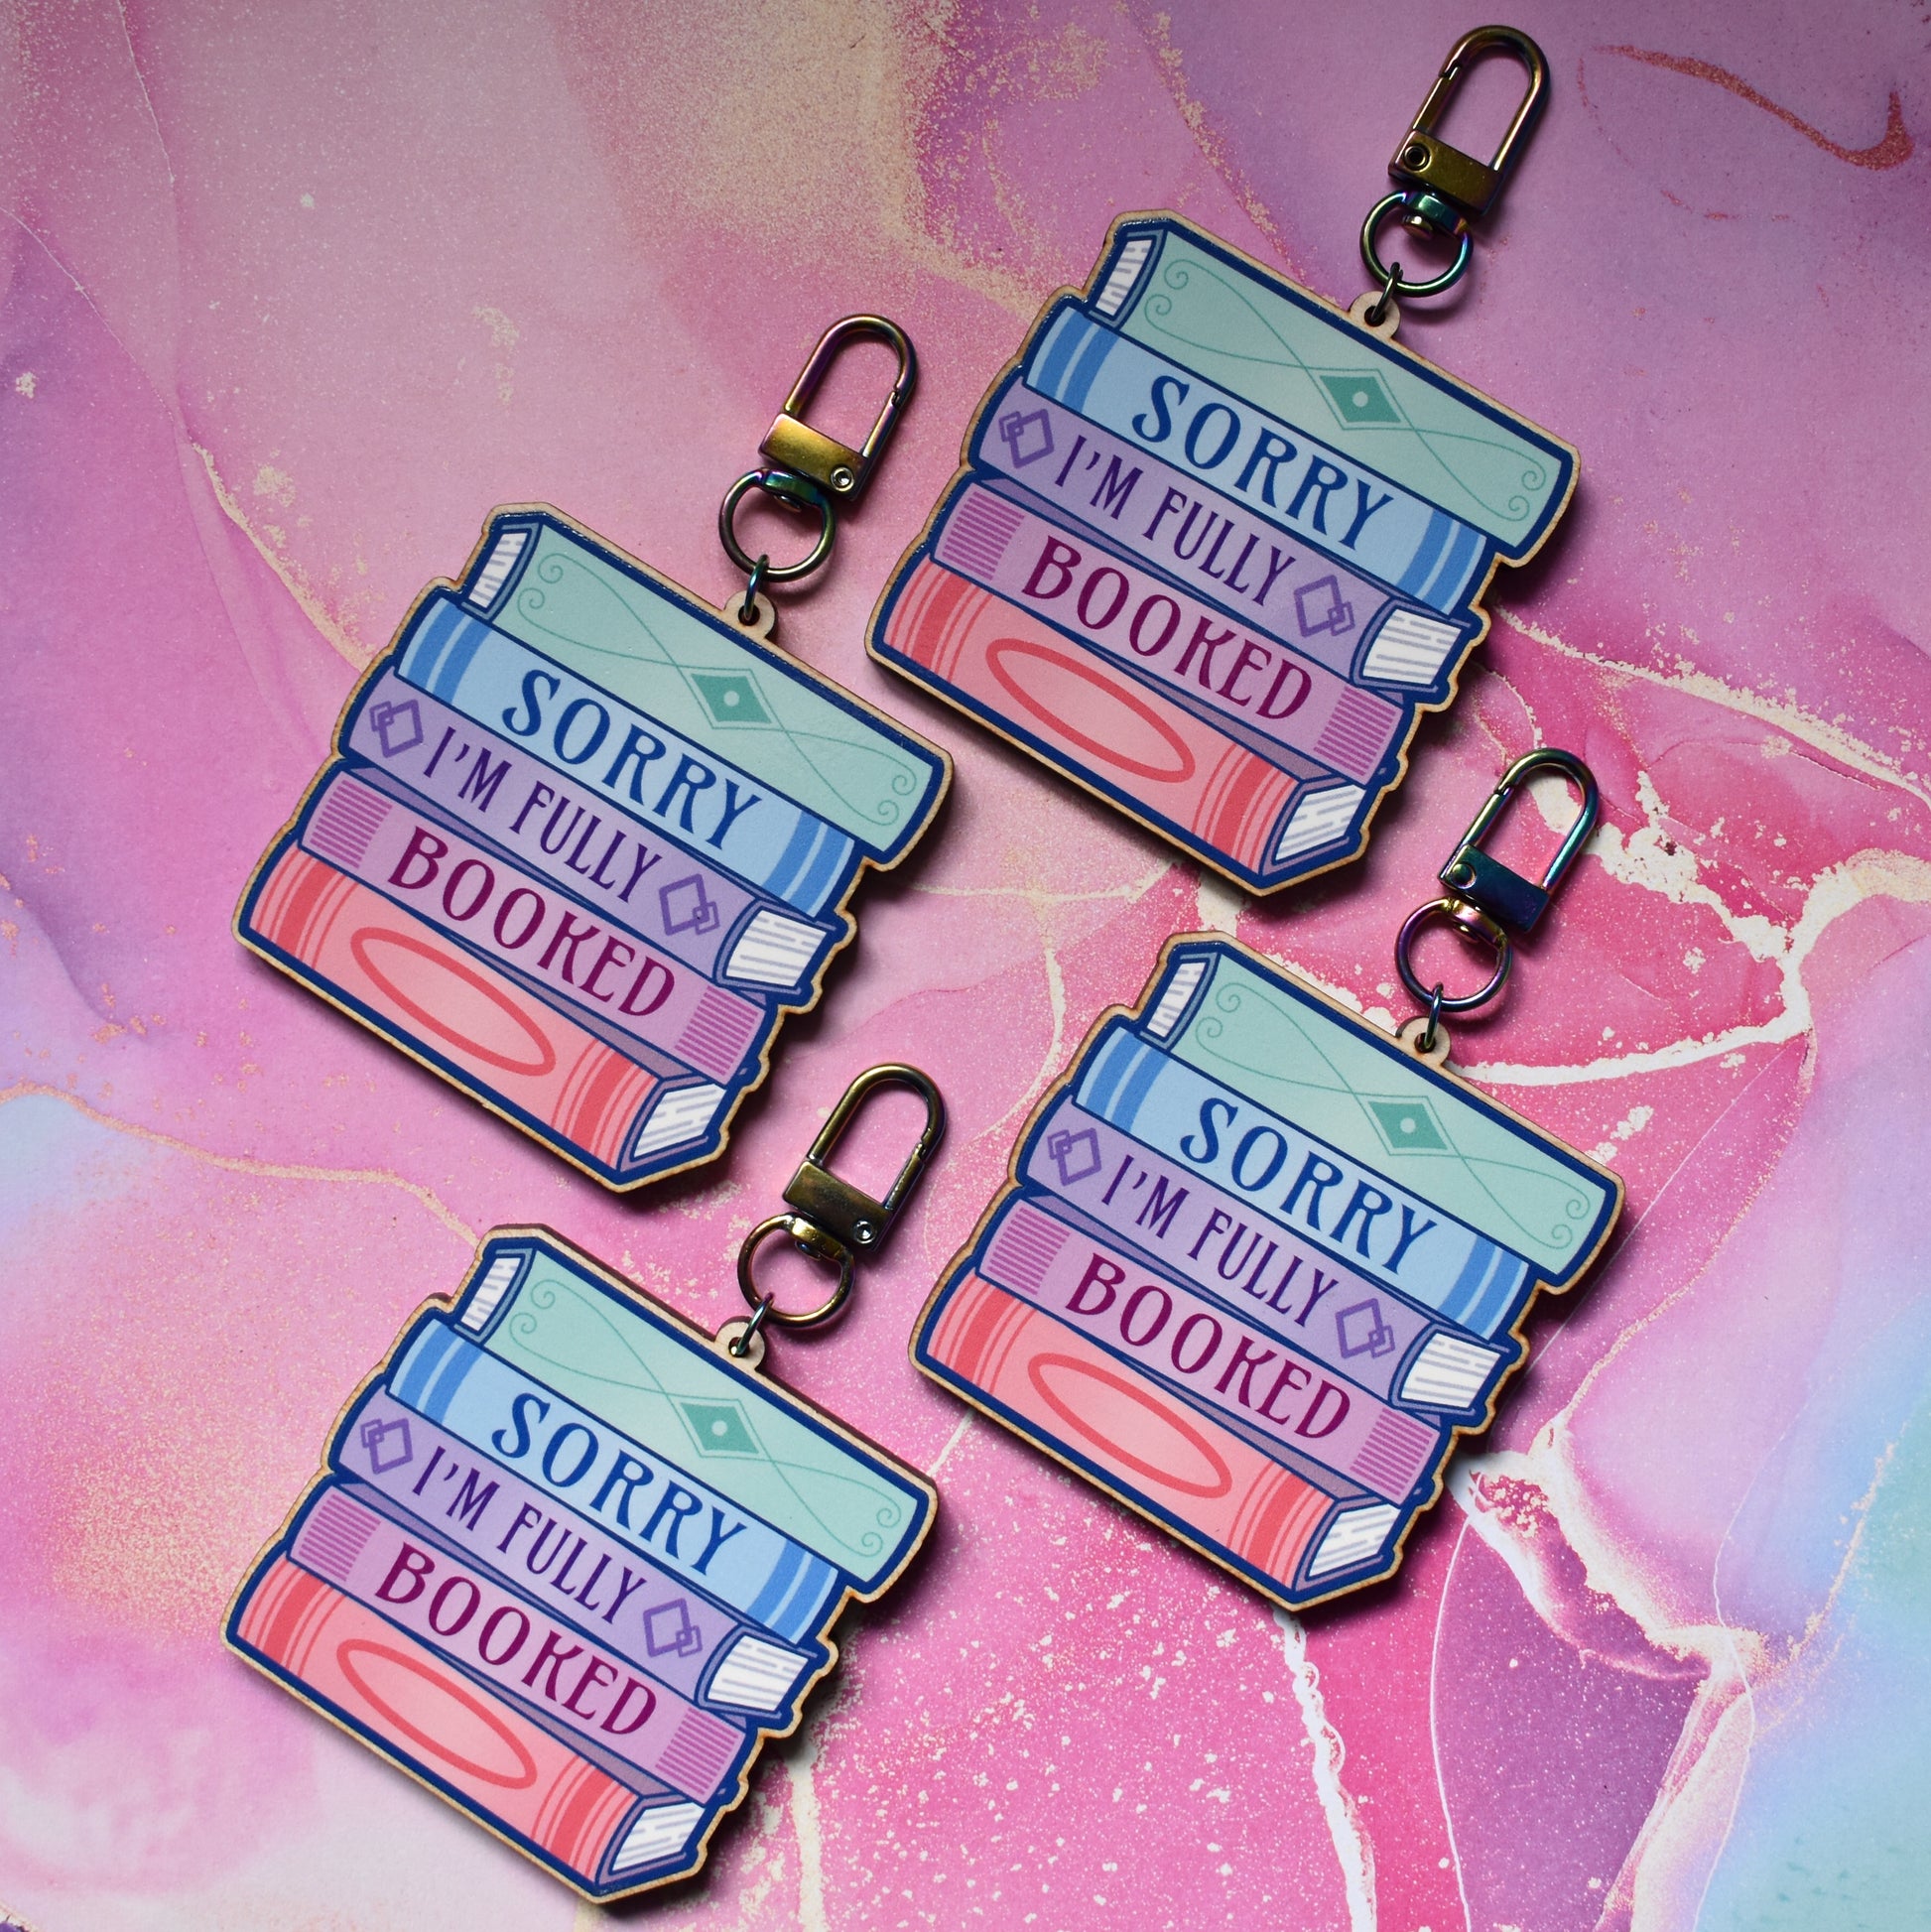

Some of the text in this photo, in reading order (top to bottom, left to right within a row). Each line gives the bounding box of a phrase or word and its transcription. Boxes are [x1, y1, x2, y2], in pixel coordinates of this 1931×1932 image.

[1055, 435, 1296, 606] I'M FULLY
[1131, 374, 1393, 551] SORRY
[1022, 536, 1312, 720] BOOKED
[424, 726, 662, 903] I'M FULLY
[502, 669, 761, 851] SORRY
[388, 827, 675, 1016] BOOKED
[1102, 1154, 1338, 1328] I'M FULLY
[1180, 1097, 1436, 1275] SORRY
[1066, 1253, 1351, 1439] BOOKED
[412, 1446, 647, 1623] I'M FULLY
[491, 1392, 747, 1576] SORRY
[375, 1542, 656, 1735] BOOKED
